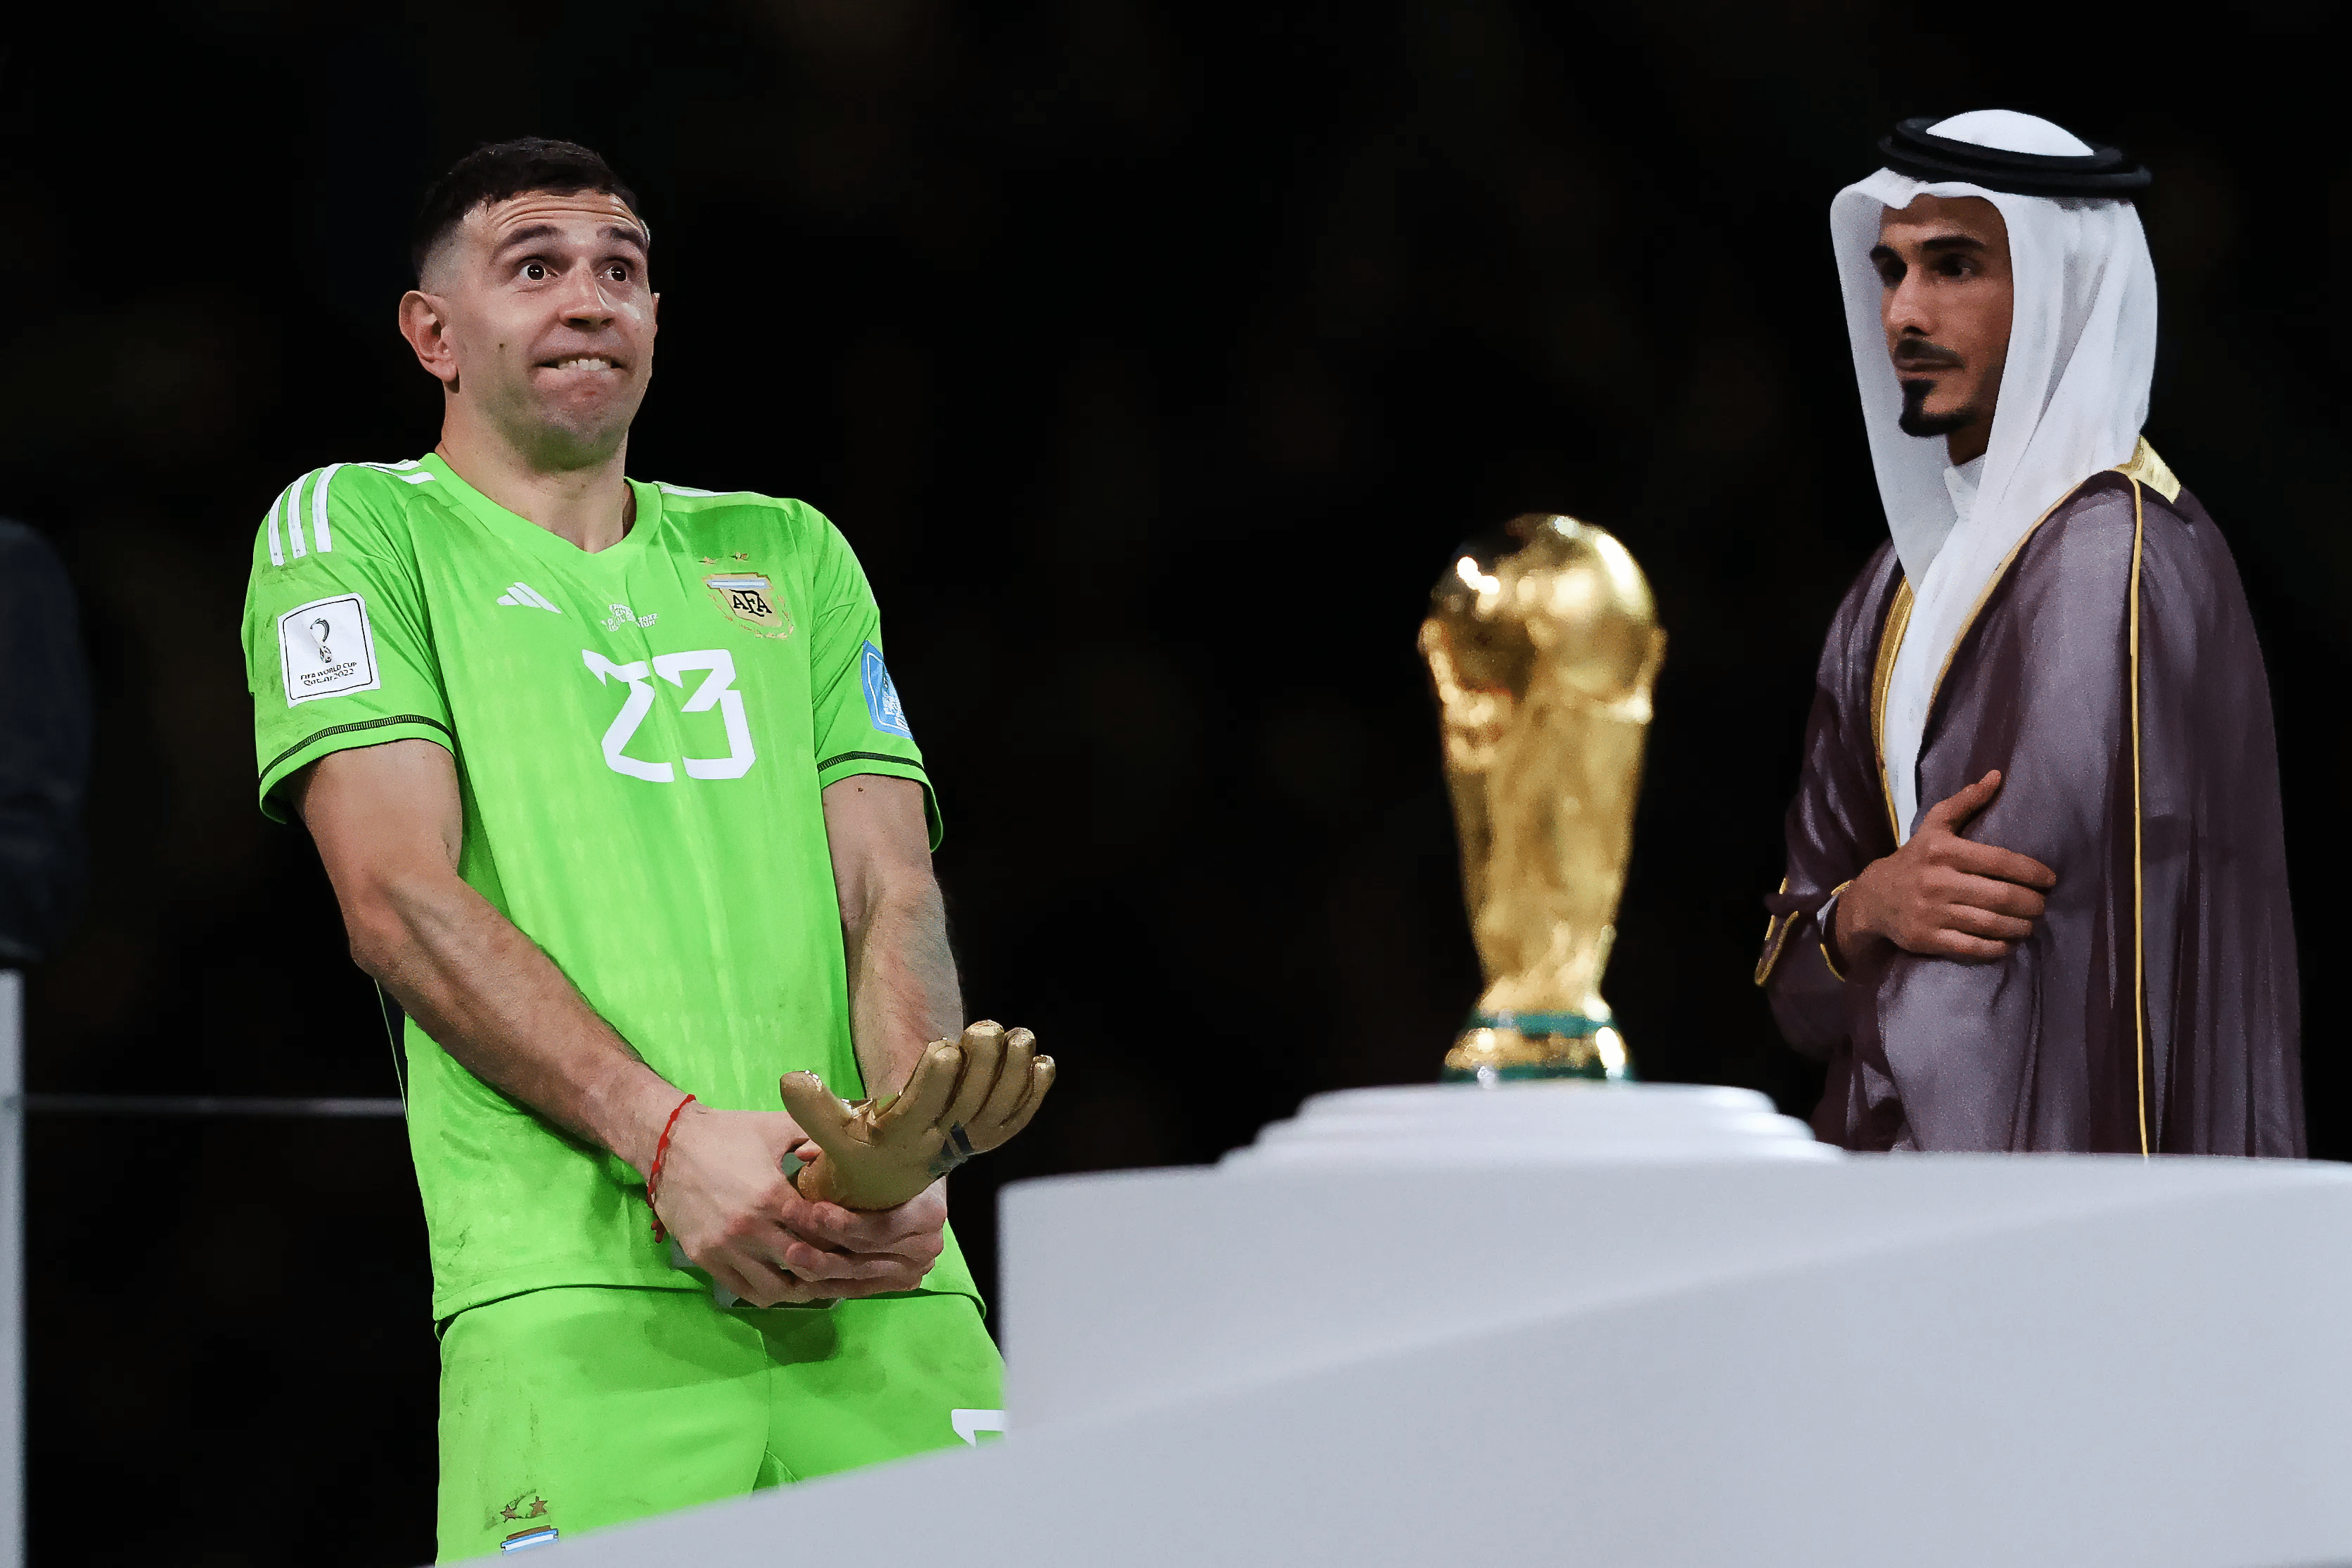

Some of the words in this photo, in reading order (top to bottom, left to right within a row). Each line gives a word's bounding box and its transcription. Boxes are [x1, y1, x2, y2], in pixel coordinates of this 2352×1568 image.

[728, 589, 773, 617] AFA
[317, 664, 342, 676] WORLD
[581, 648, 757, 783] 23
